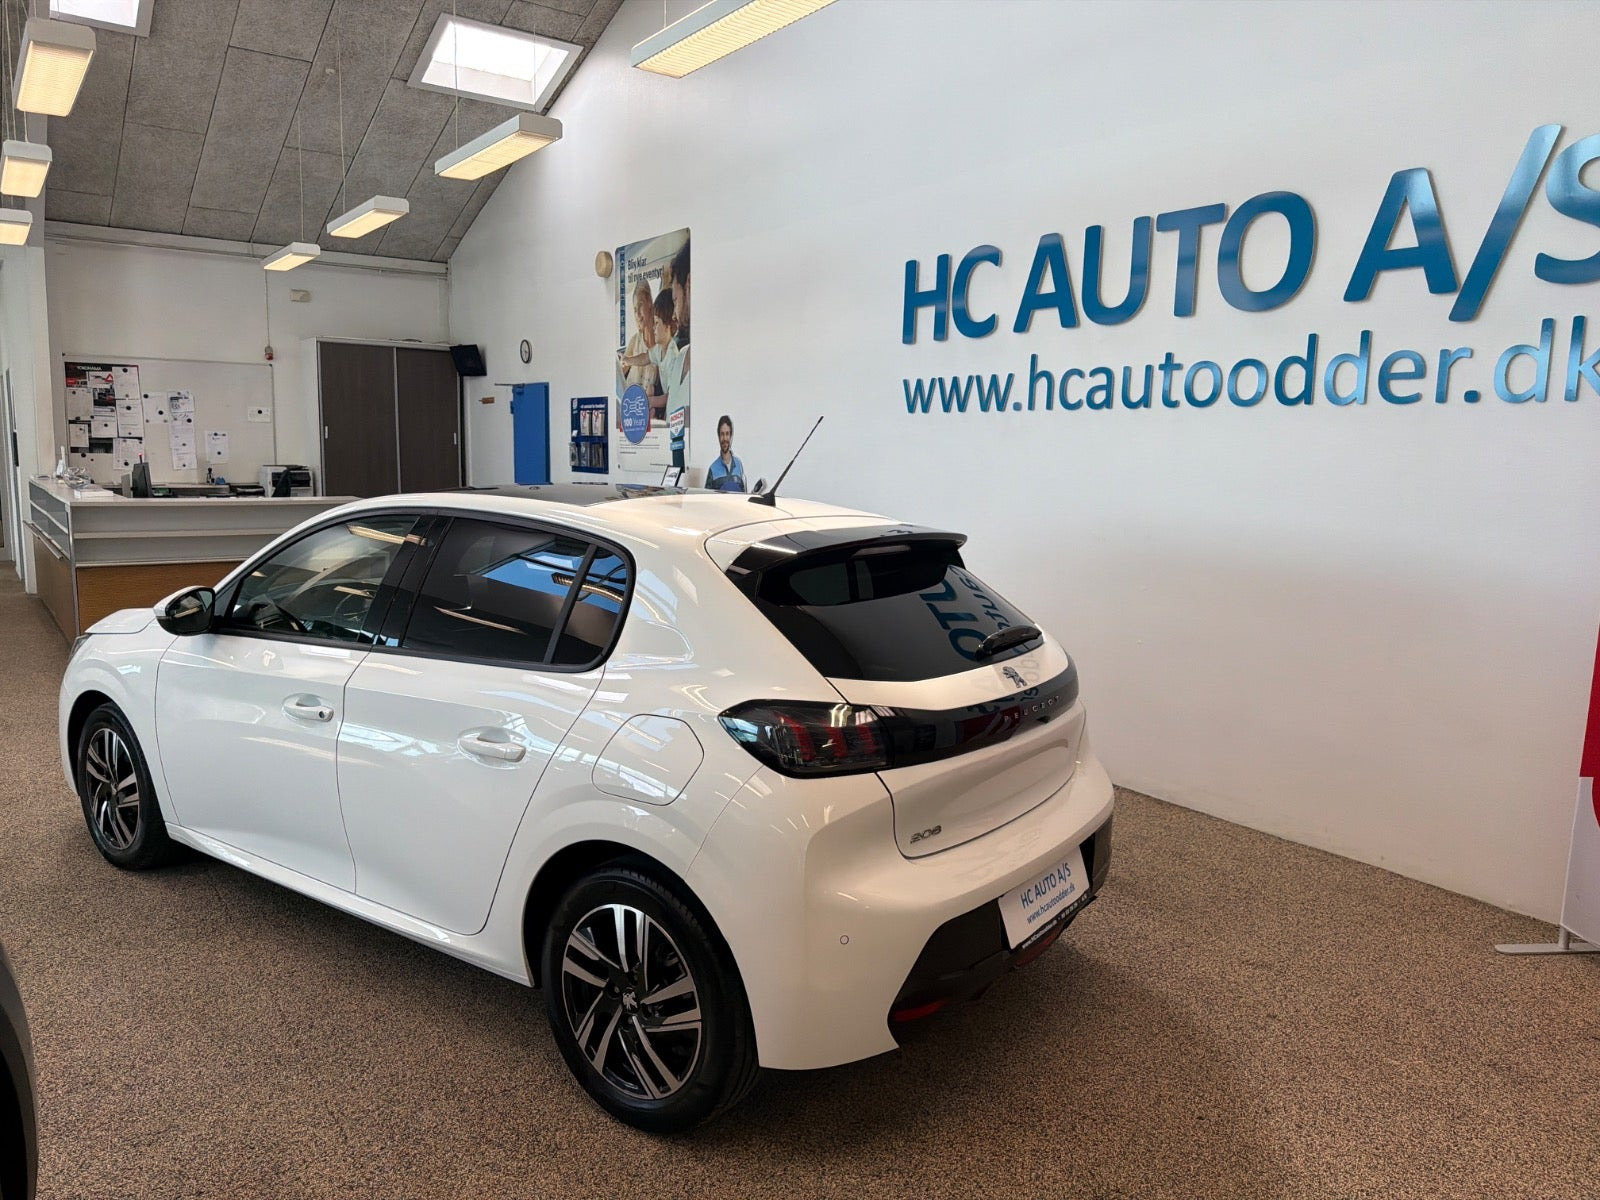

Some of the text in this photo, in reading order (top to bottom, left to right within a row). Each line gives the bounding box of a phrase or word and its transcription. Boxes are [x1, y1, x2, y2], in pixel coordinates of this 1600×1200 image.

[902, 123, 1600, 345] HC AUTO A/S
[902, 314, 1600, 414] www.hcautoodder.dk
[910, 825, 942, 844] 208
[1020, 888, 1035, 909] HC
[1034, 873, 1057, 900] AUTO
[1057, 862, 1071, 884] A/S
